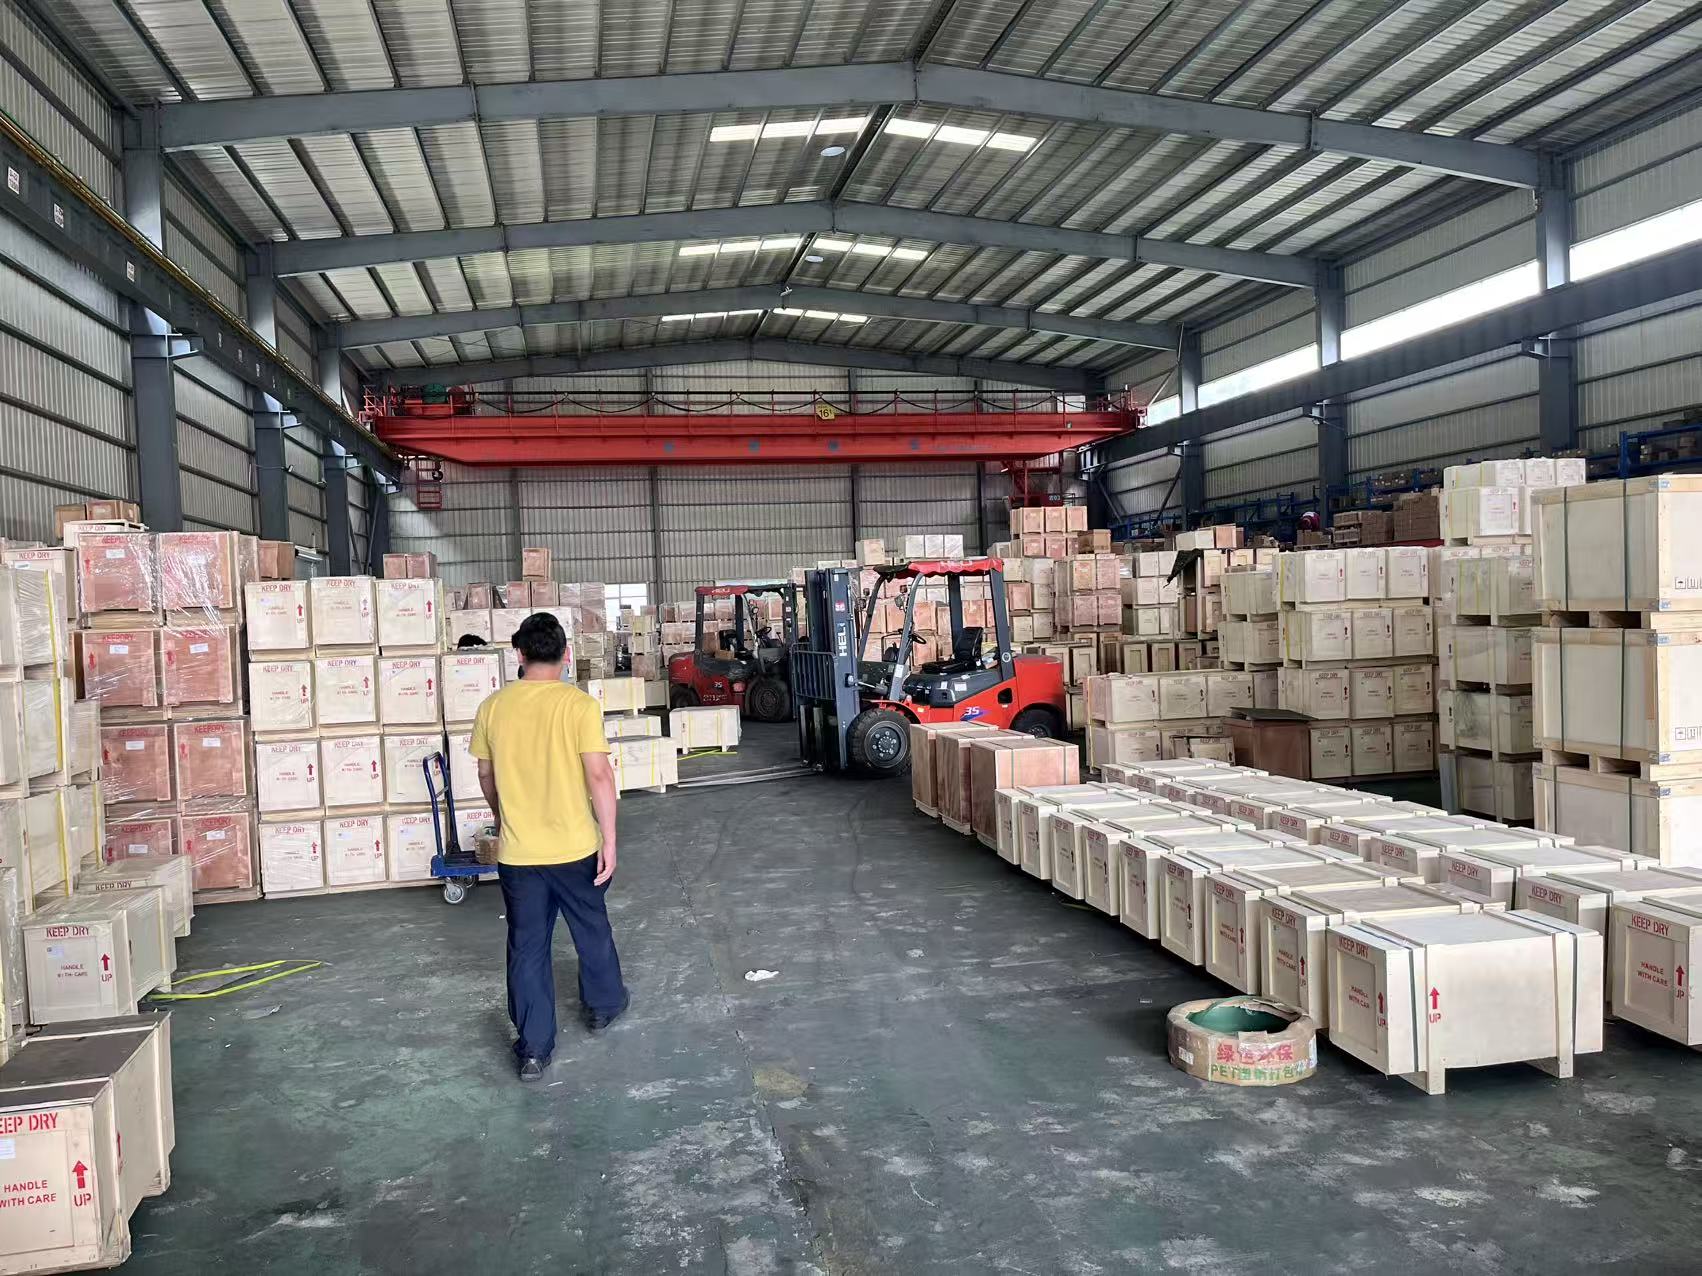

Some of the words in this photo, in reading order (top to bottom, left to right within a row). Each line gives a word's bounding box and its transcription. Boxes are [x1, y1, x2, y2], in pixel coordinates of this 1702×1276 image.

[964, 706, 980, 716] 35
[1330, 832, 1340, 841] KEEP
[1341, 834, 1350, 843] DRY
[1381, 844, 1394, 854] KEEP
[1395, 847, 1405, 857] DRY
[1452, 863, 1466, 873] KEEP
[1467, 867, 1479, 877] DRY
[1532, 885, 1547, 898] KEEP
[1549, 890, 1562, 904] DRY
[1272, 908, 1284, 921] KEEP
[1286, 911, 1296, 926] DRY
[46, 926, 69, 937] KEEP
[73, 926, 89, 935] DRY
[1632, 914, 1650, 930] KEEP
[1653, 920, 1670, 936] DRY
[1339, 936, 1354, 951] KEEP
[1356, 943, 1369, 958] DRY
[1641, 961, 1664, 975] HANDLE
[1637, 970, 1651, 981] WITH
[1429, 1013, 1441, 1023] UP
[0, 1116, 23, 1134] EP
[29, 1112, 58, 1131] DRY
[4, 1180, 48, 1192] HANDLE
[28, 1193, 56, 1204] CARE
[74, 1193, 92, 1206] UP
